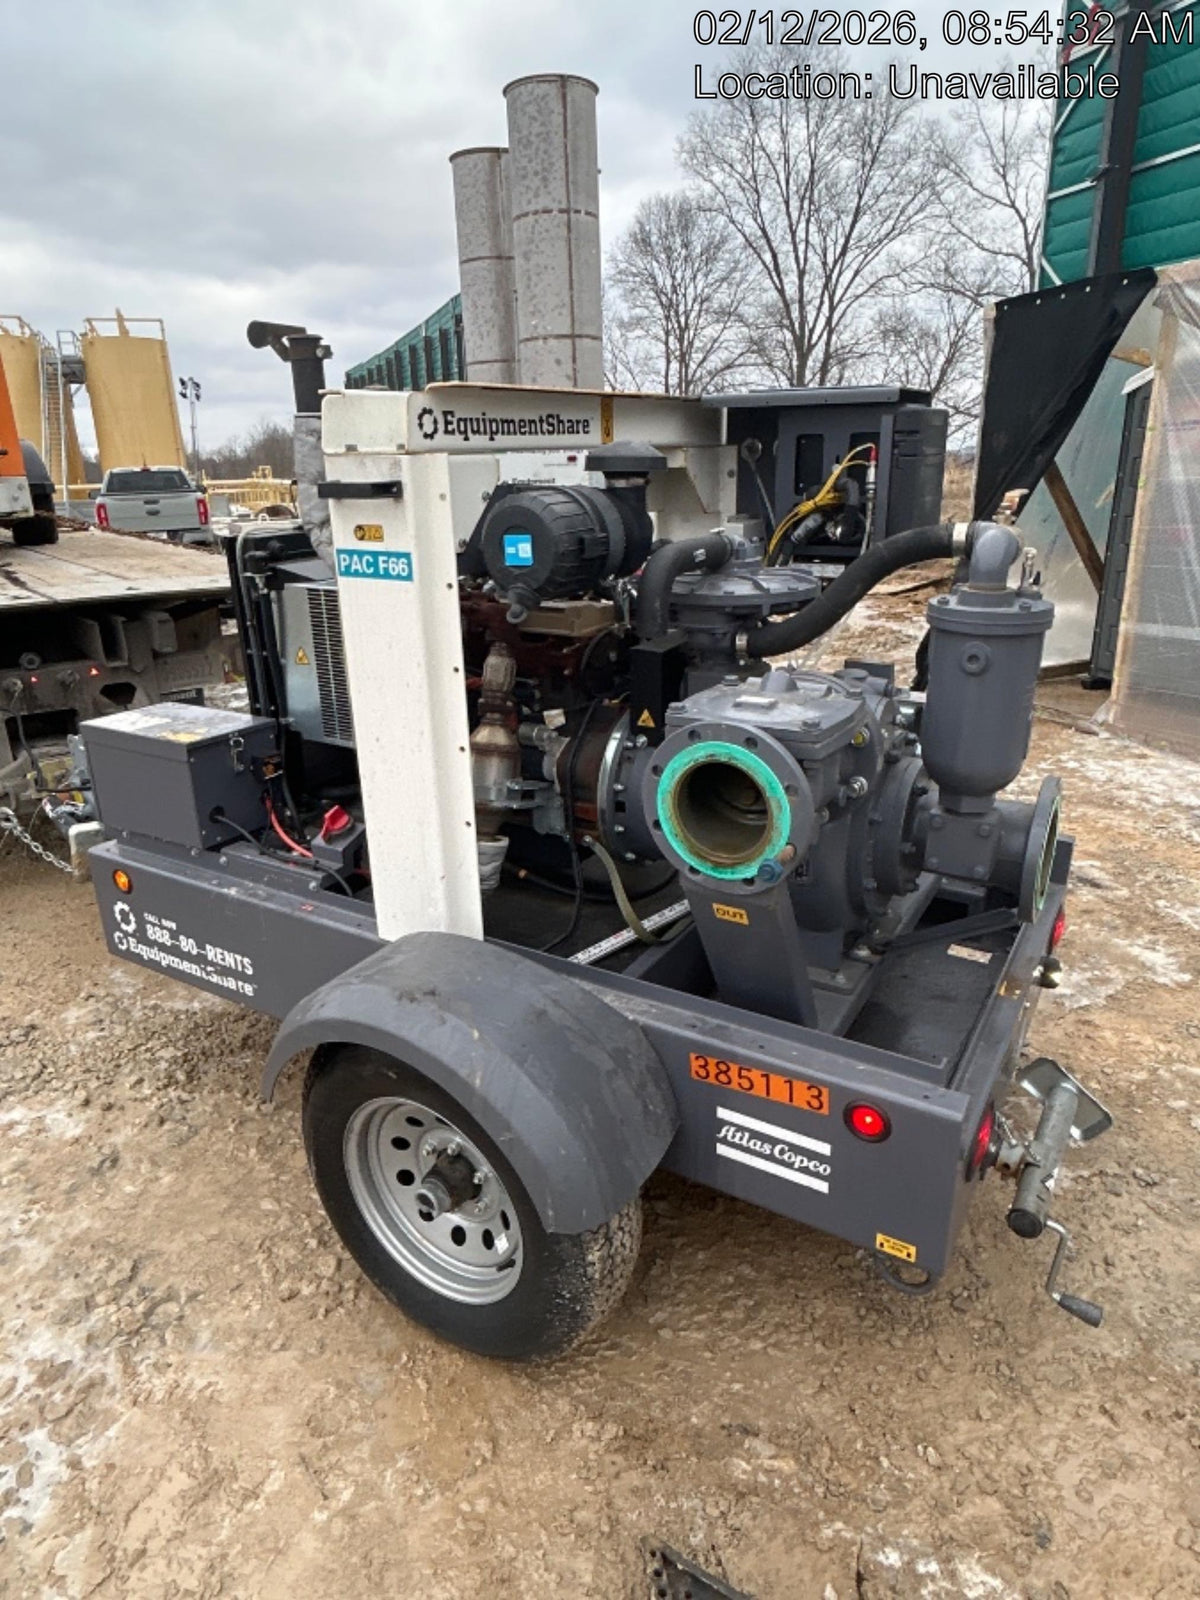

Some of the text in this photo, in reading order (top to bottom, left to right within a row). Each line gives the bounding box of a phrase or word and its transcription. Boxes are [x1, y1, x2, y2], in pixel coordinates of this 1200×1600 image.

[441, 410, 591, 441] EquipmentShare
[339, 553, 409, 577] PAC F66
[716, 907, 745, 920] OUT
[694, 1055, 824, 1111] 385113
[716, 1124, 831, 1175] Atlas Copco
